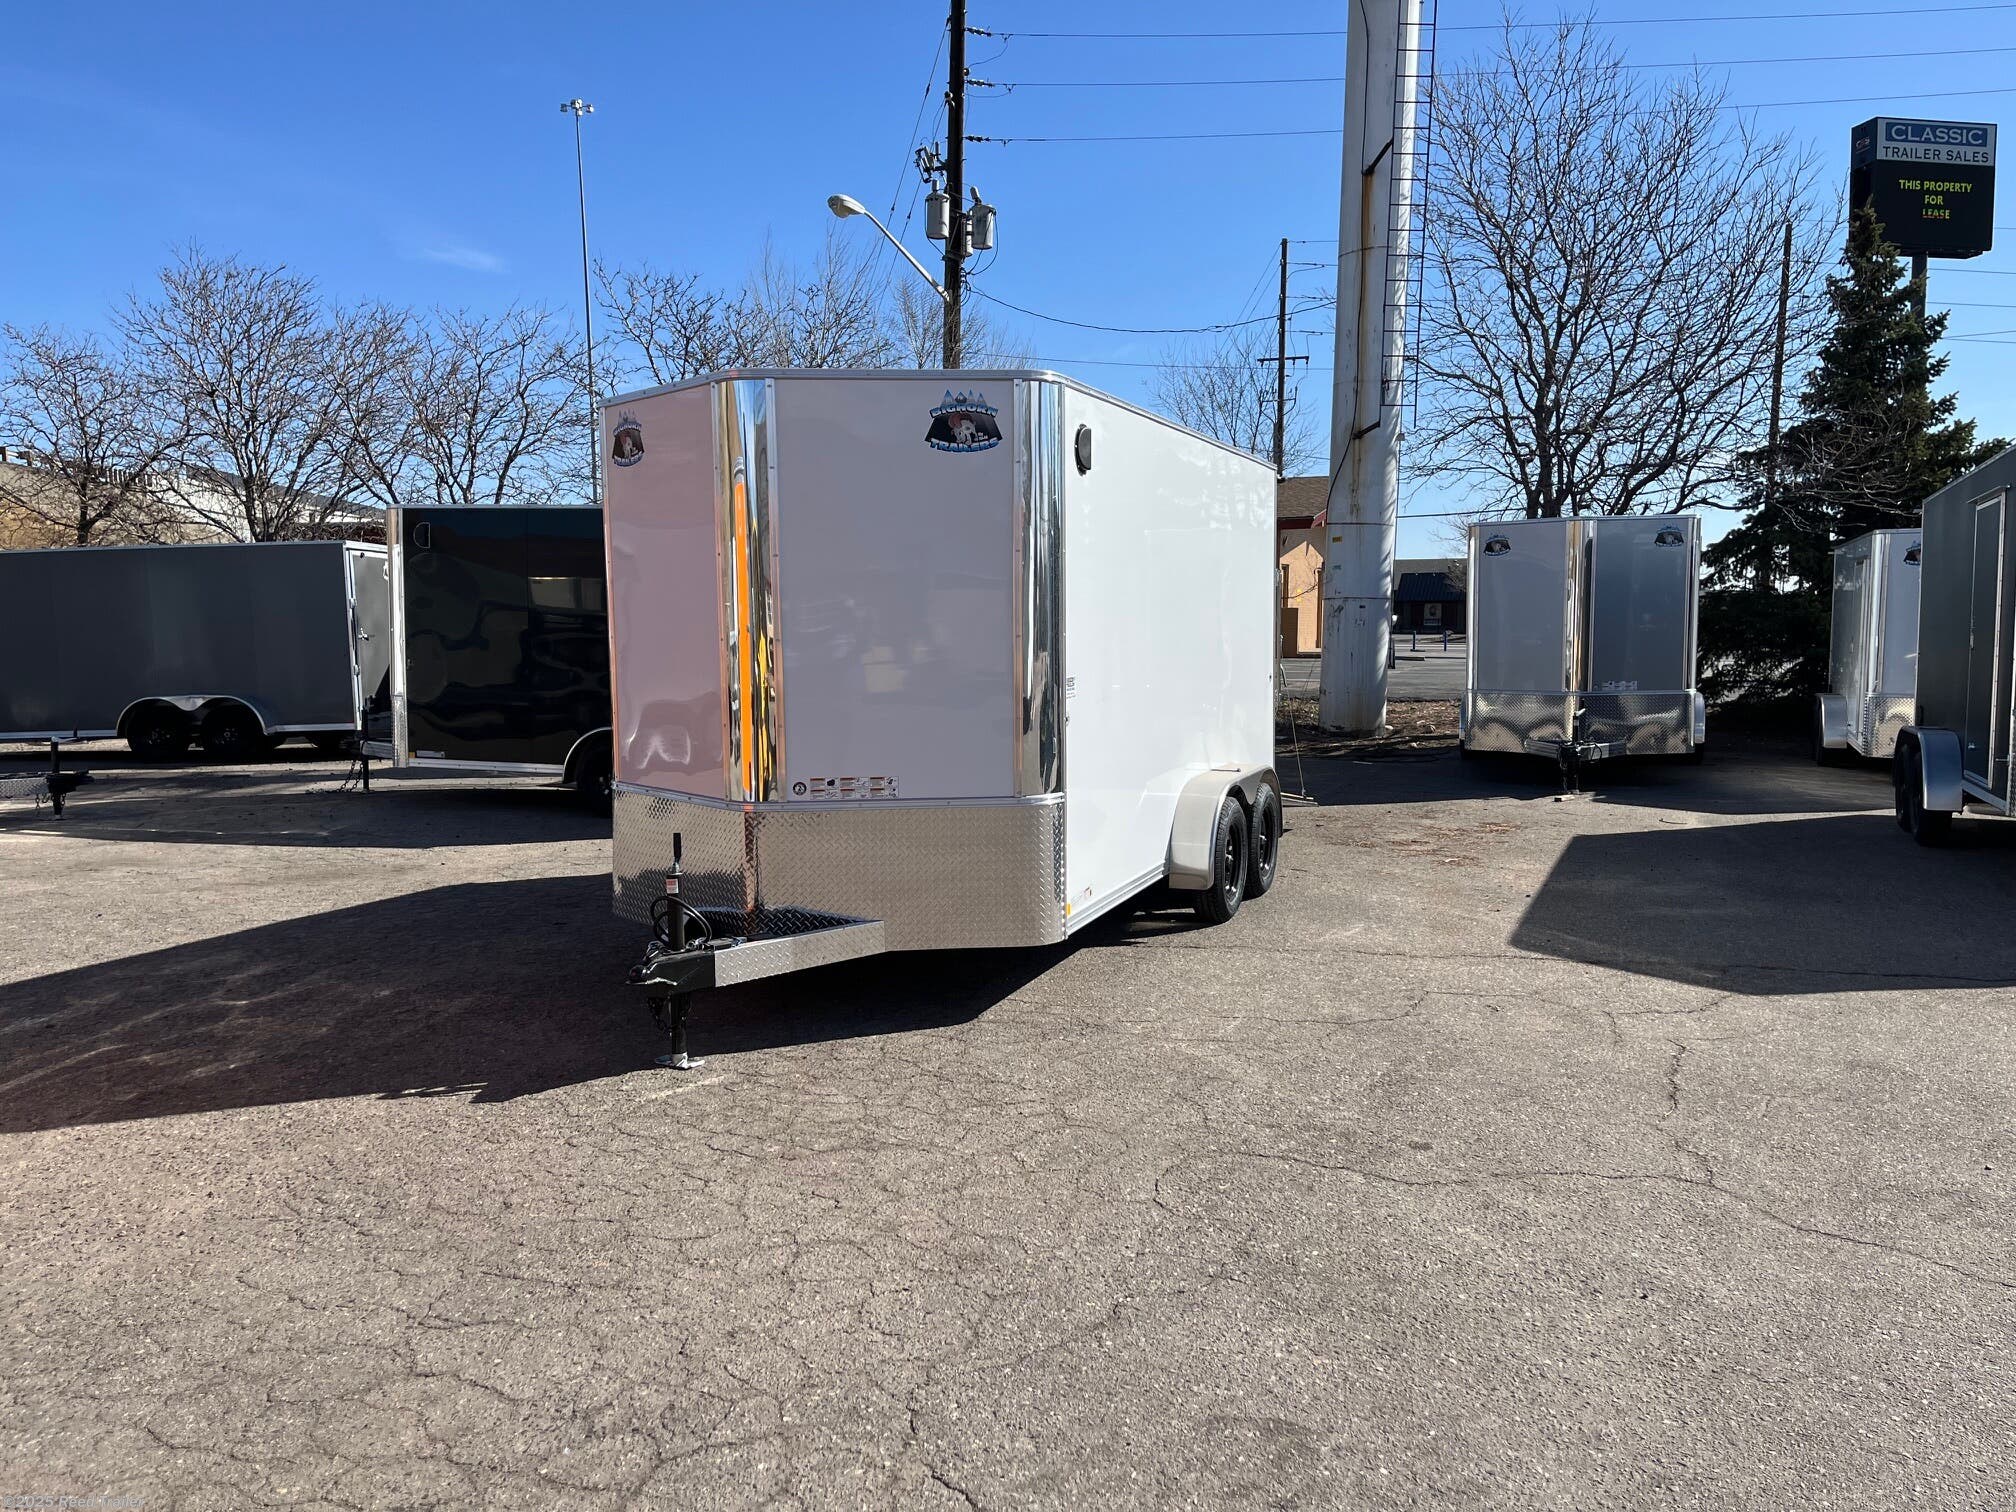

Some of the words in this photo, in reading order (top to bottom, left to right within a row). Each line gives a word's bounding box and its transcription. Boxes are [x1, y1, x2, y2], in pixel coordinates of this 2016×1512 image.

[1891, 125, 1983, 145] CLASSIC
[1882, 146, 1941, 161] TRAILER
[1946, 150, 1989, 163] SALES
[1899, 179, 1921, 190] THIS
[1923, 181, 1972, 193] PROPERTY
[1924, 195, 1944, 205] FOR
[1922, 209, 1950, 219] LEASE
[930, 403, 998, 418] BIGHORN
[930, 437, 1000, 452] TRAILERS
